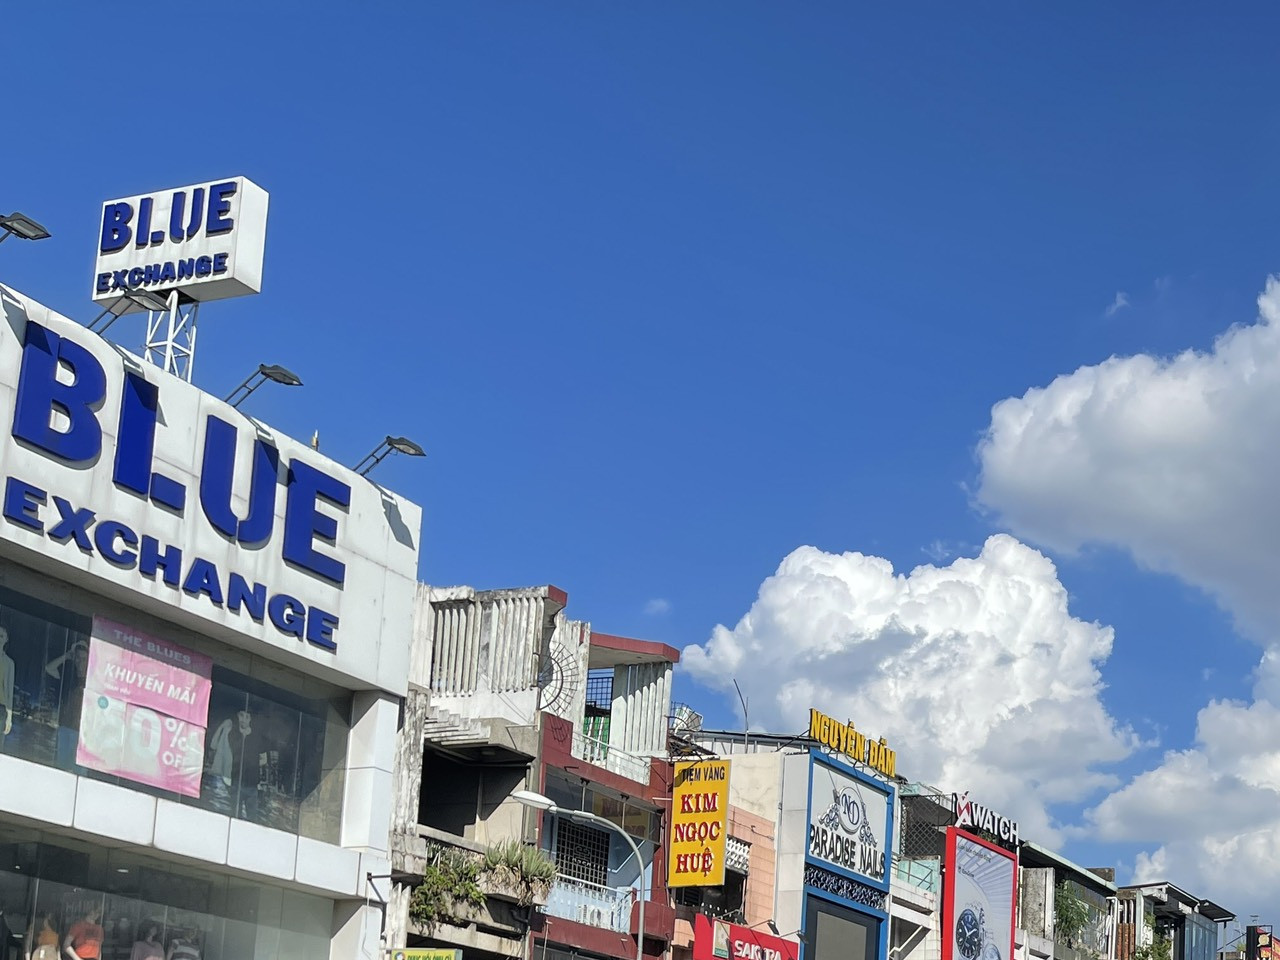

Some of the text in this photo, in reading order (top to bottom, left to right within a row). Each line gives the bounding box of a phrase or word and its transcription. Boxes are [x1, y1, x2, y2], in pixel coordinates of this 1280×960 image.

[101, 182, 237, 252] BLUE
[97, 252, 228, 294] EXCHANGE
[12, 321, 352, 584] BLUE
[3, 477, 340, 652] EXCHANGE
[114, 629, 191, 665] THE BLUES
[104, 663, 164, 694] KHUYẾN
[167, 684, 197, 705] MÃI
[682, 764, 725, 785] TIỆM VÀNG
[680, 792, 718, 813] KIM
[673, 821, 721, 847] NGỌC
[810, 824, 886, 880] PARADISE NAILS
[675, 847, 714, 877] HUỆ
